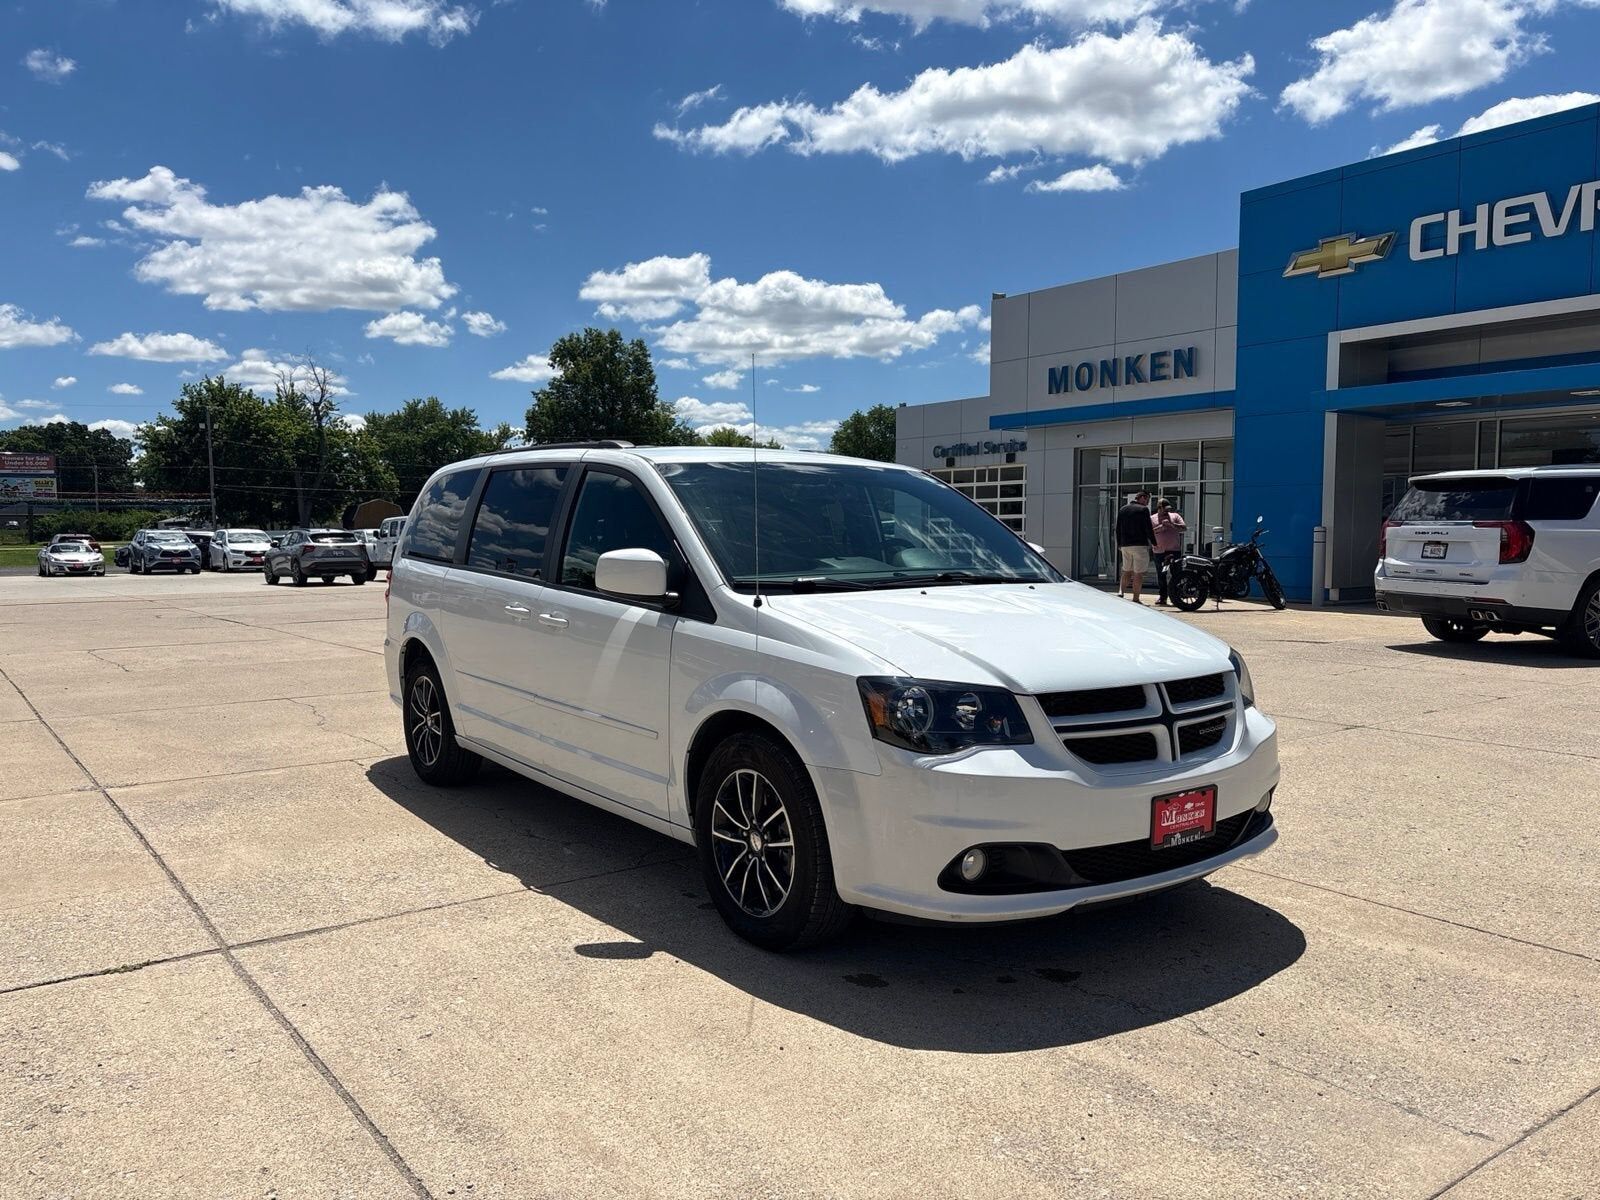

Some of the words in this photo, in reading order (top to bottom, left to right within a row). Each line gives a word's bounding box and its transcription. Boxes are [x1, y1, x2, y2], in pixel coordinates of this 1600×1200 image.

[1048, 346, 1196, 395] MONKEN
[933, 441, 980, 458] Certified
[983, 438, 1028, 455] Service
